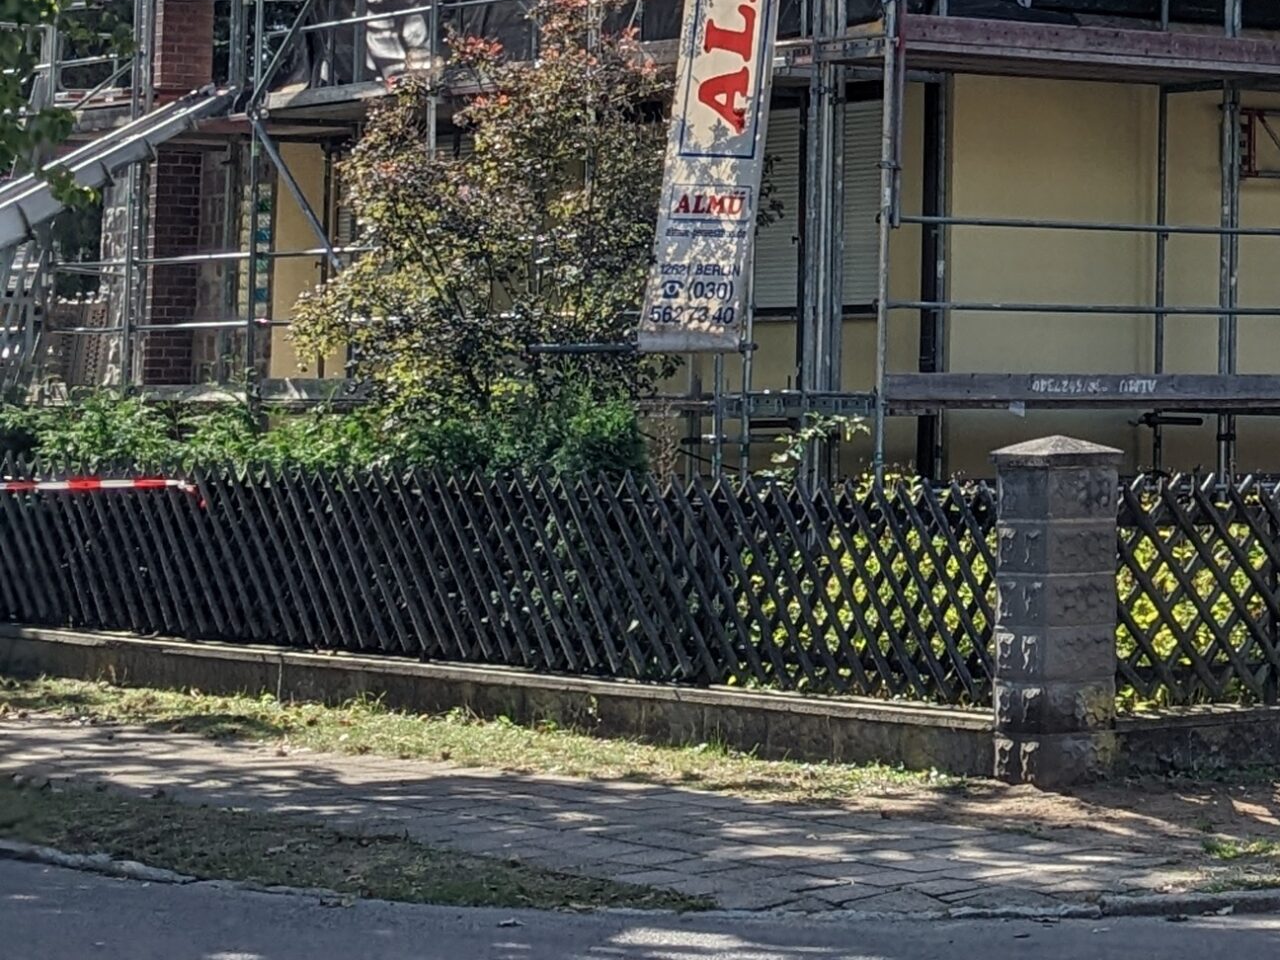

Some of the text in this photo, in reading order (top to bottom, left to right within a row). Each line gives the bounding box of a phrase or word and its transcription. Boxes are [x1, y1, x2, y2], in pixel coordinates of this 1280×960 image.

[674, 191, 745, 215] ALMÜ
[695, 263, 741, 277] BERLIN
[687, 280, 734, 303] (030)
[650, 305, 735, 324] 562 73 40
